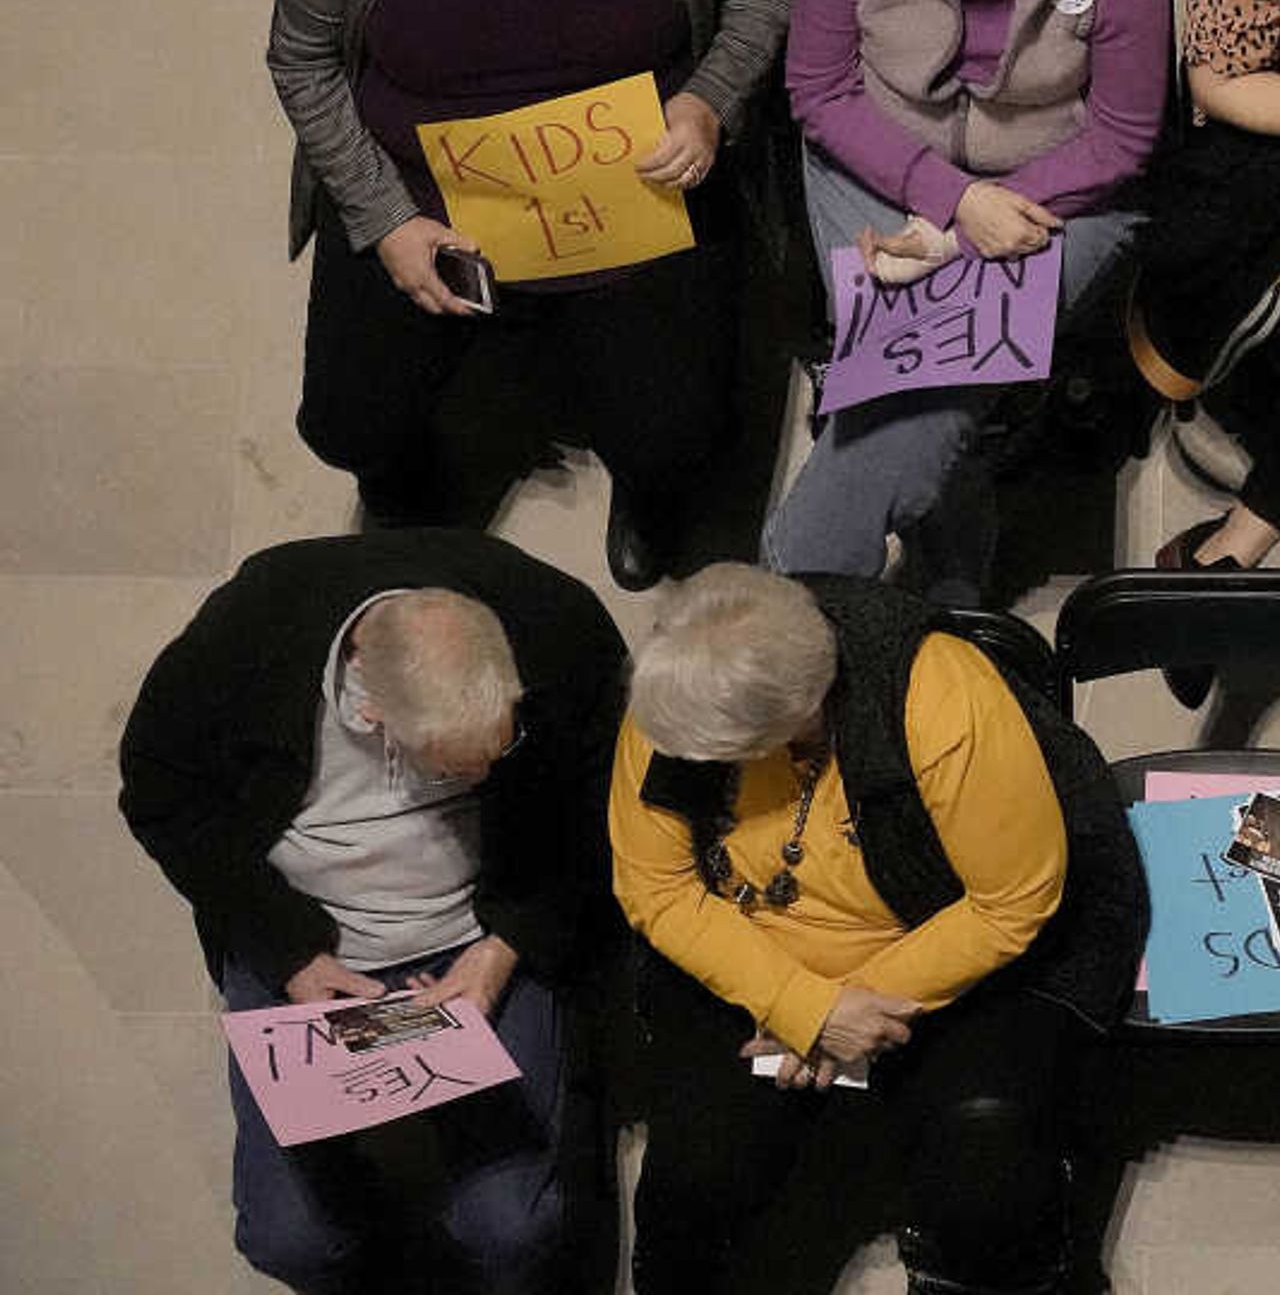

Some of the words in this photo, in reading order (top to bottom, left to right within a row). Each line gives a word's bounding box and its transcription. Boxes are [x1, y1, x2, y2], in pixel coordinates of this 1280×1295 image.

[438, 101, 633, 189] KIDS
[525, 193, 606, 261] 1st
[883, 291, 1034, 374] YES
[344, 1054, 477, 1105] YES
